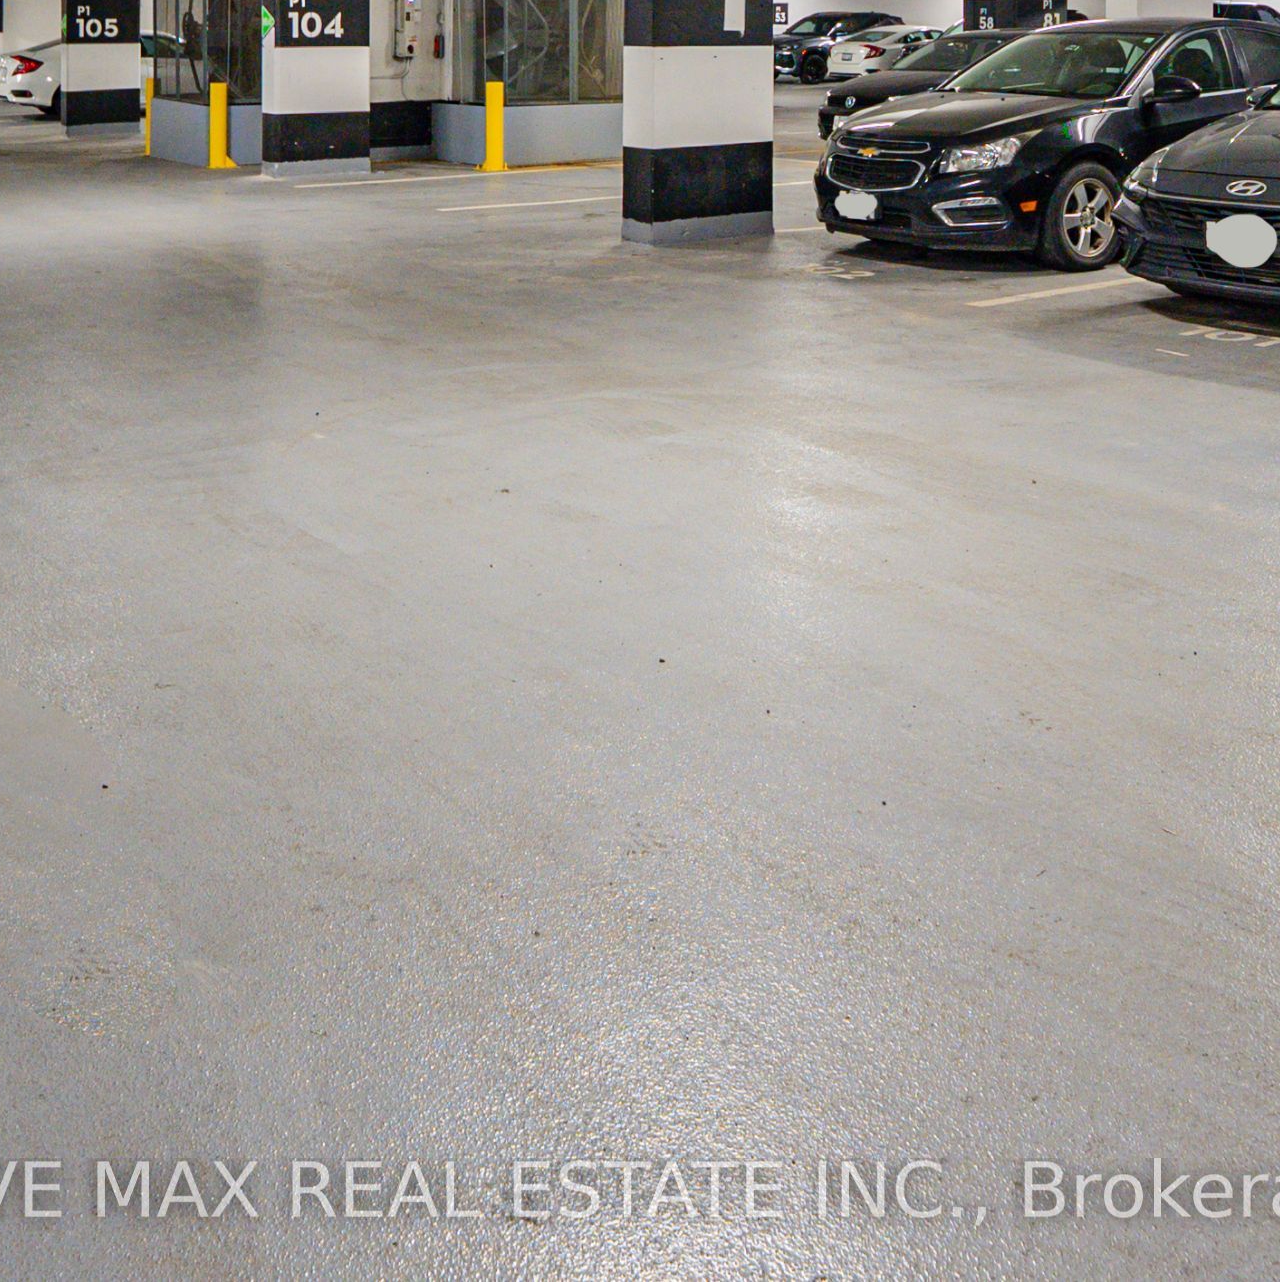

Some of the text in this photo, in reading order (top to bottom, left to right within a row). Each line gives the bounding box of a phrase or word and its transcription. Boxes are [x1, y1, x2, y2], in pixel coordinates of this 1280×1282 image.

[76, 5, 91, 16] P1
[1042, 0, 1053, 10] P1
[774, 12, 786, 23] 53
[979, 16, 994, 30] 58
[1043, 12, 1061, 28] 81
[75, 18, 119, 38] 105
[288, 11, 344, 39] 104
